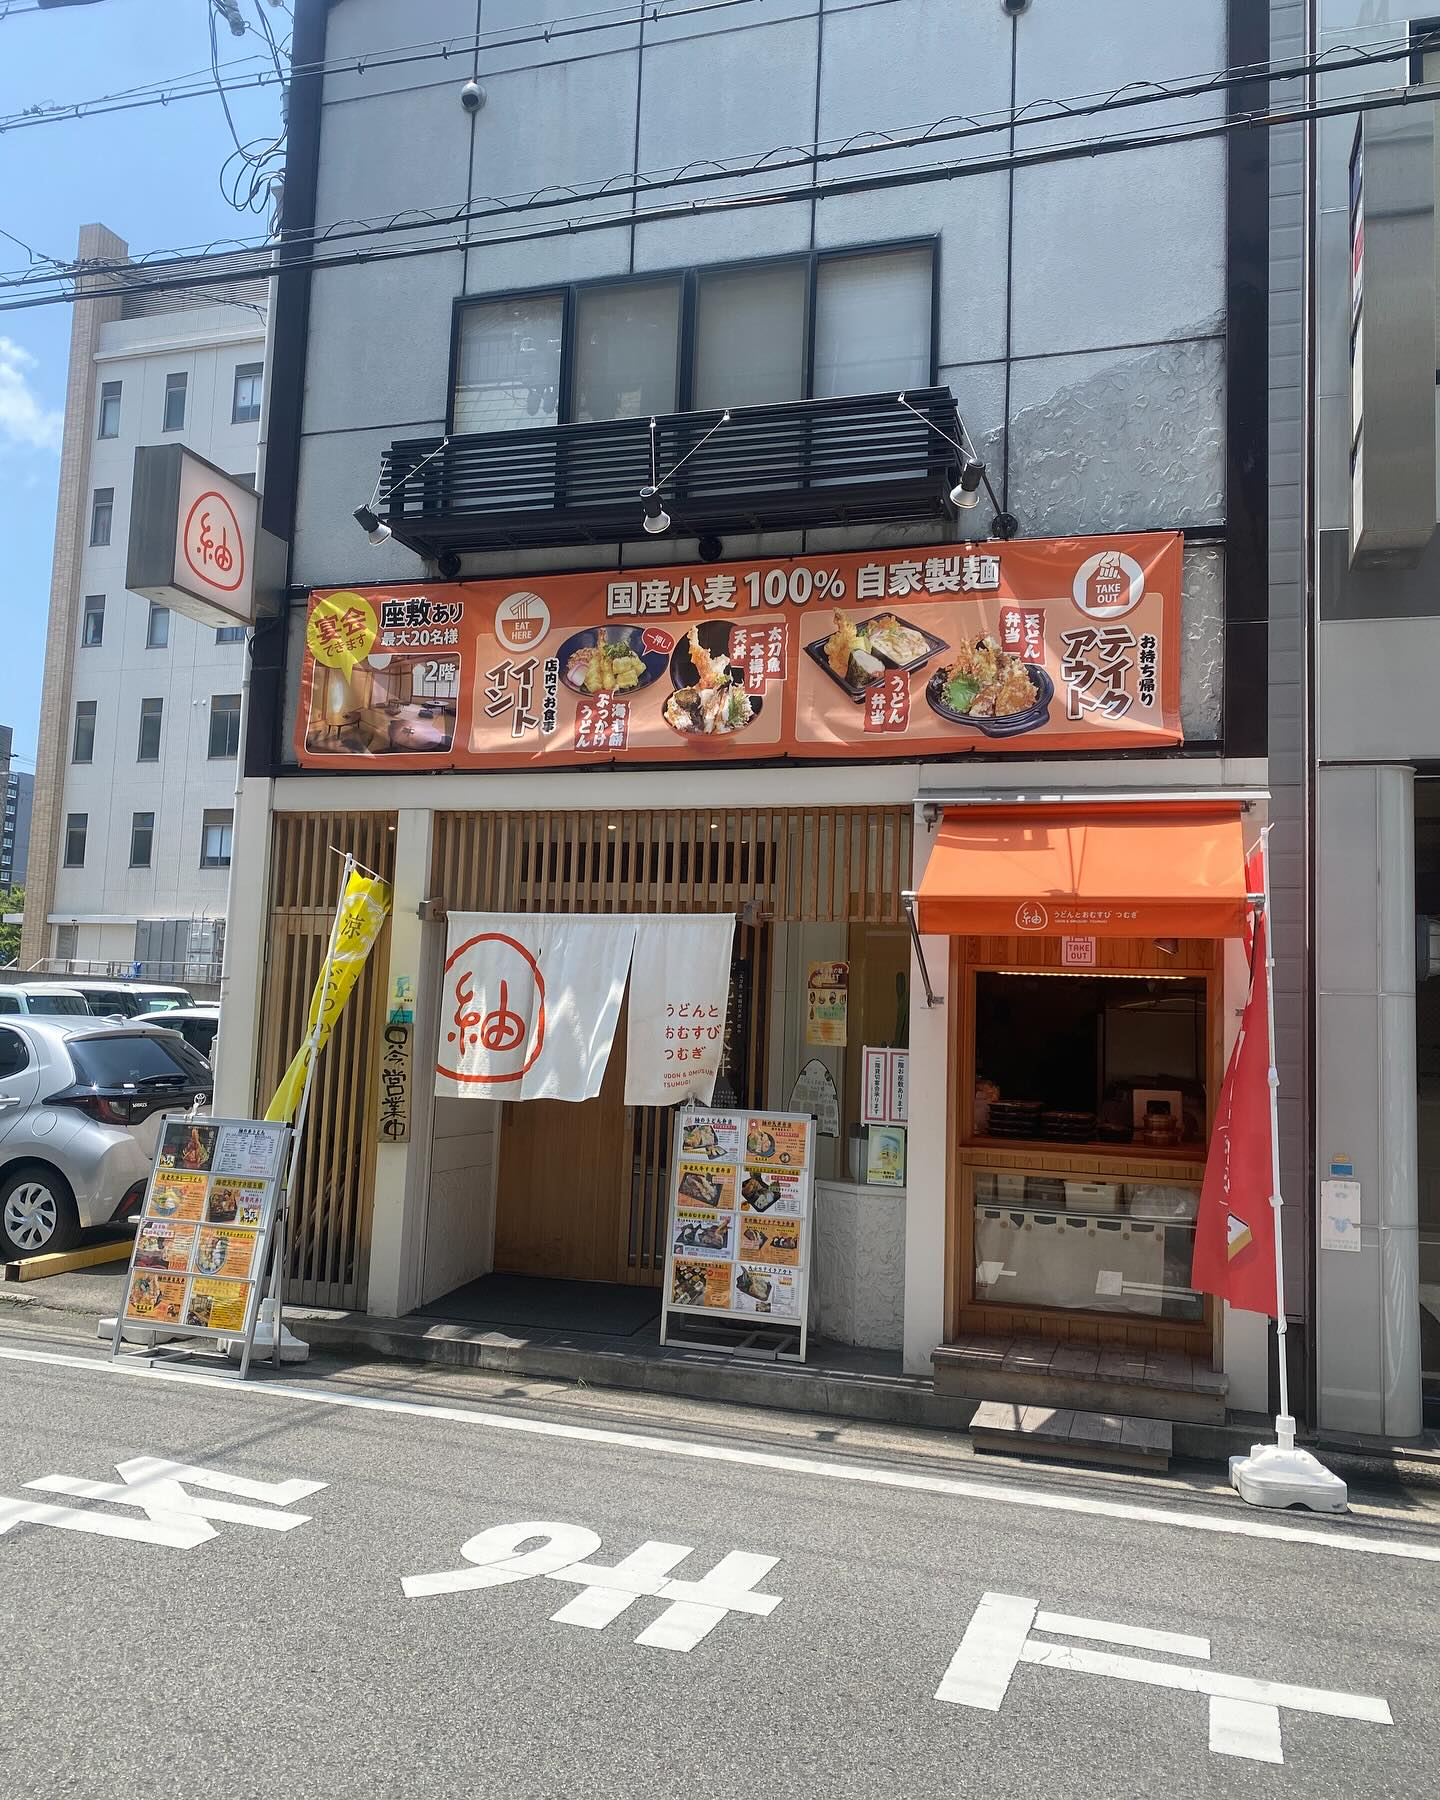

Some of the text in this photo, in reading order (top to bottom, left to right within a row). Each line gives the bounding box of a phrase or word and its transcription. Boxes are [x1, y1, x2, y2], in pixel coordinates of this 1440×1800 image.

[606, 555, 1001, 617] 国産小麦 100% 自家製麺
[1095, 583, 1121, 594] TAKE
[1096, 593, 1119, 604] OUT
[314, 606, 367, 646] 宴会
[380, 597, 464, 629] 座敷あり
[515, 621, 531, 631] EAT
[1003, 611, 1021, 644] 弁当
[322, 633, 367, 658] できます
[380, 628, 460, 647] 最大20名様
[511, 630, 533, 641] HERE
[733, 629, 747, 660] 天丼
[1023, 613, 1041, 659] 天どん
[425, 660, 456, 684] 2階
[748, 631, 765, 689] 一本揚げ
[1060, 625, 1099, 720] アウト
[1100, 623, 1137, 720] テイク
[1138, 634, 1158, 708] お持ち帰り
[484, 658, 514, 718] イン
[509, 656, 540, 738] イート
[543, 657, 560, 735] 店内でお食事
[887, 675, 905, 724] うどん
[592, 693, 611, 747] ぶっかけ
[870, 692, 887, 725] 弁当
[576, 705, 593, 748] うどん
[340, 912, 366, 940] 涼
[1053, 910, 1112, 920] うどんとおむすび
[1067, 944, 1090, 952] TAKE
[1070, 952, 1088, 960] OUT
[665, 1002, 719, 1019] うどんと
[664, 1024, 723, 1041] おむすび
[664, 1046, 707, 1061] つむぎ
[663, 1072, 682, 1080] UDON
[663, 1079, 692, 1089] TSUMUGI
